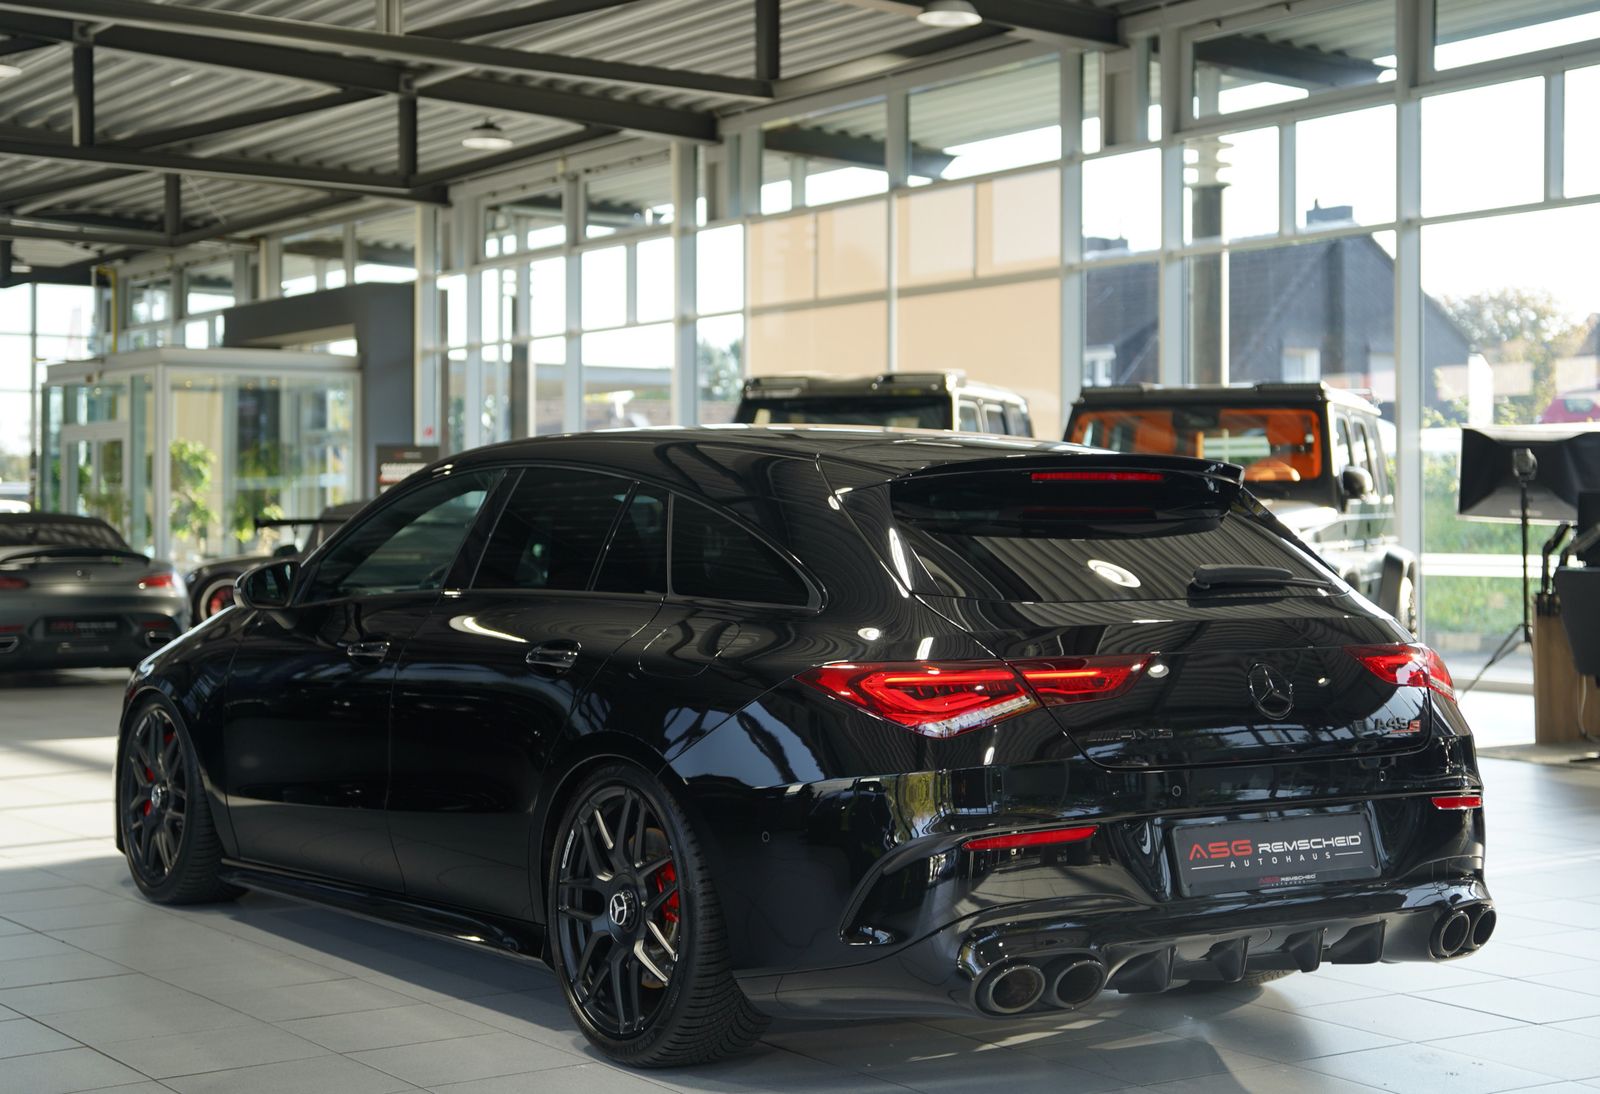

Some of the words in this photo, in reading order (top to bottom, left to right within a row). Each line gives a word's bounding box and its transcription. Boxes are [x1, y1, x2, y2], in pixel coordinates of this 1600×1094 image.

[1189, 840, 1253, 861] ASG
[1258, 834, 1362, 854] REMSCHEID
[1230, 852, 1331, 869] AUTOHAUS
